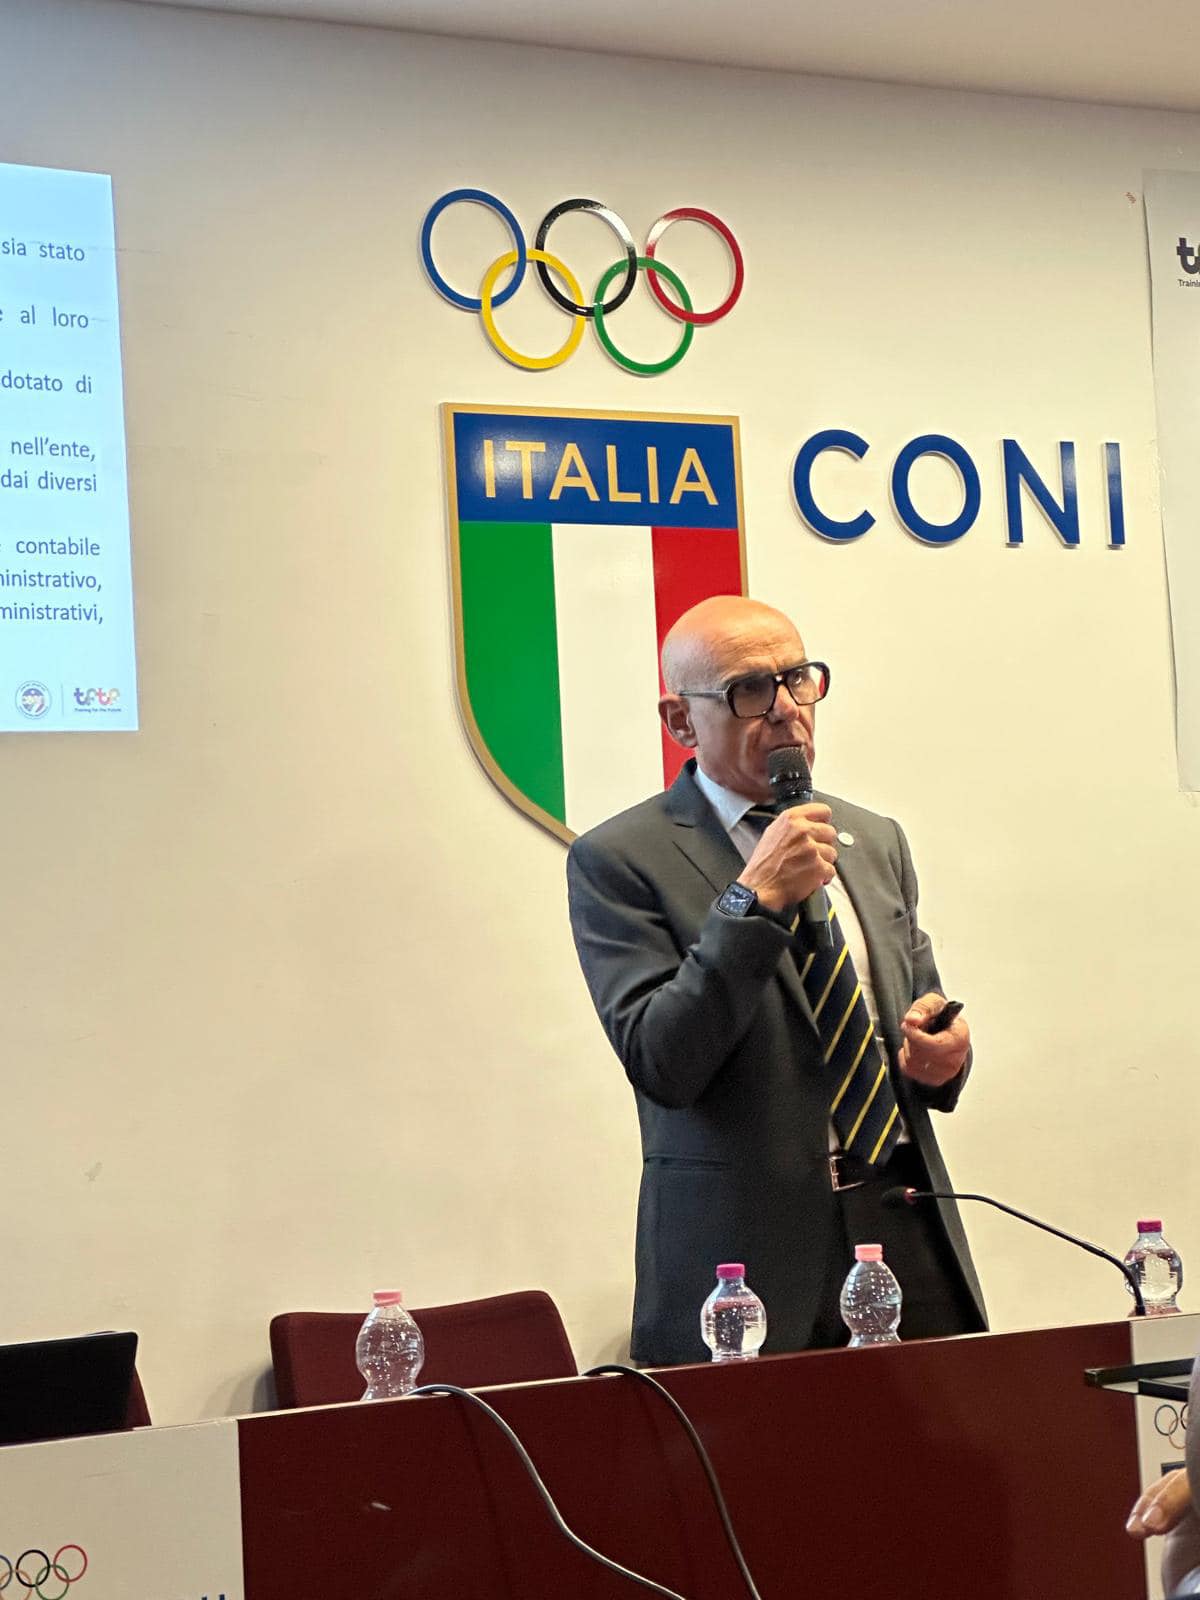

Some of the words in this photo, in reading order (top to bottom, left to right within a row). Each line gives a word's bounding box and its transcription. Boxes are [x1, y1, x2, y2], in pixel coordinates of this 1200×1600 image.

[1, 237, 27, 256] sia
[39, 242, 85, 262] stato
[20, 304, 36, 325] al
[52, 306, 89, 329] loro
[1, 369, 63, 392] dotato
[75, 374, 92, 394] di
[0, 468, 28, 489] dai
[37, 470, 97, 492] diversi
[483, 439, 719, 506] ITALIA
[791, 428, 1126, 548] CONI
[15, 536, 101, 556] contabile
